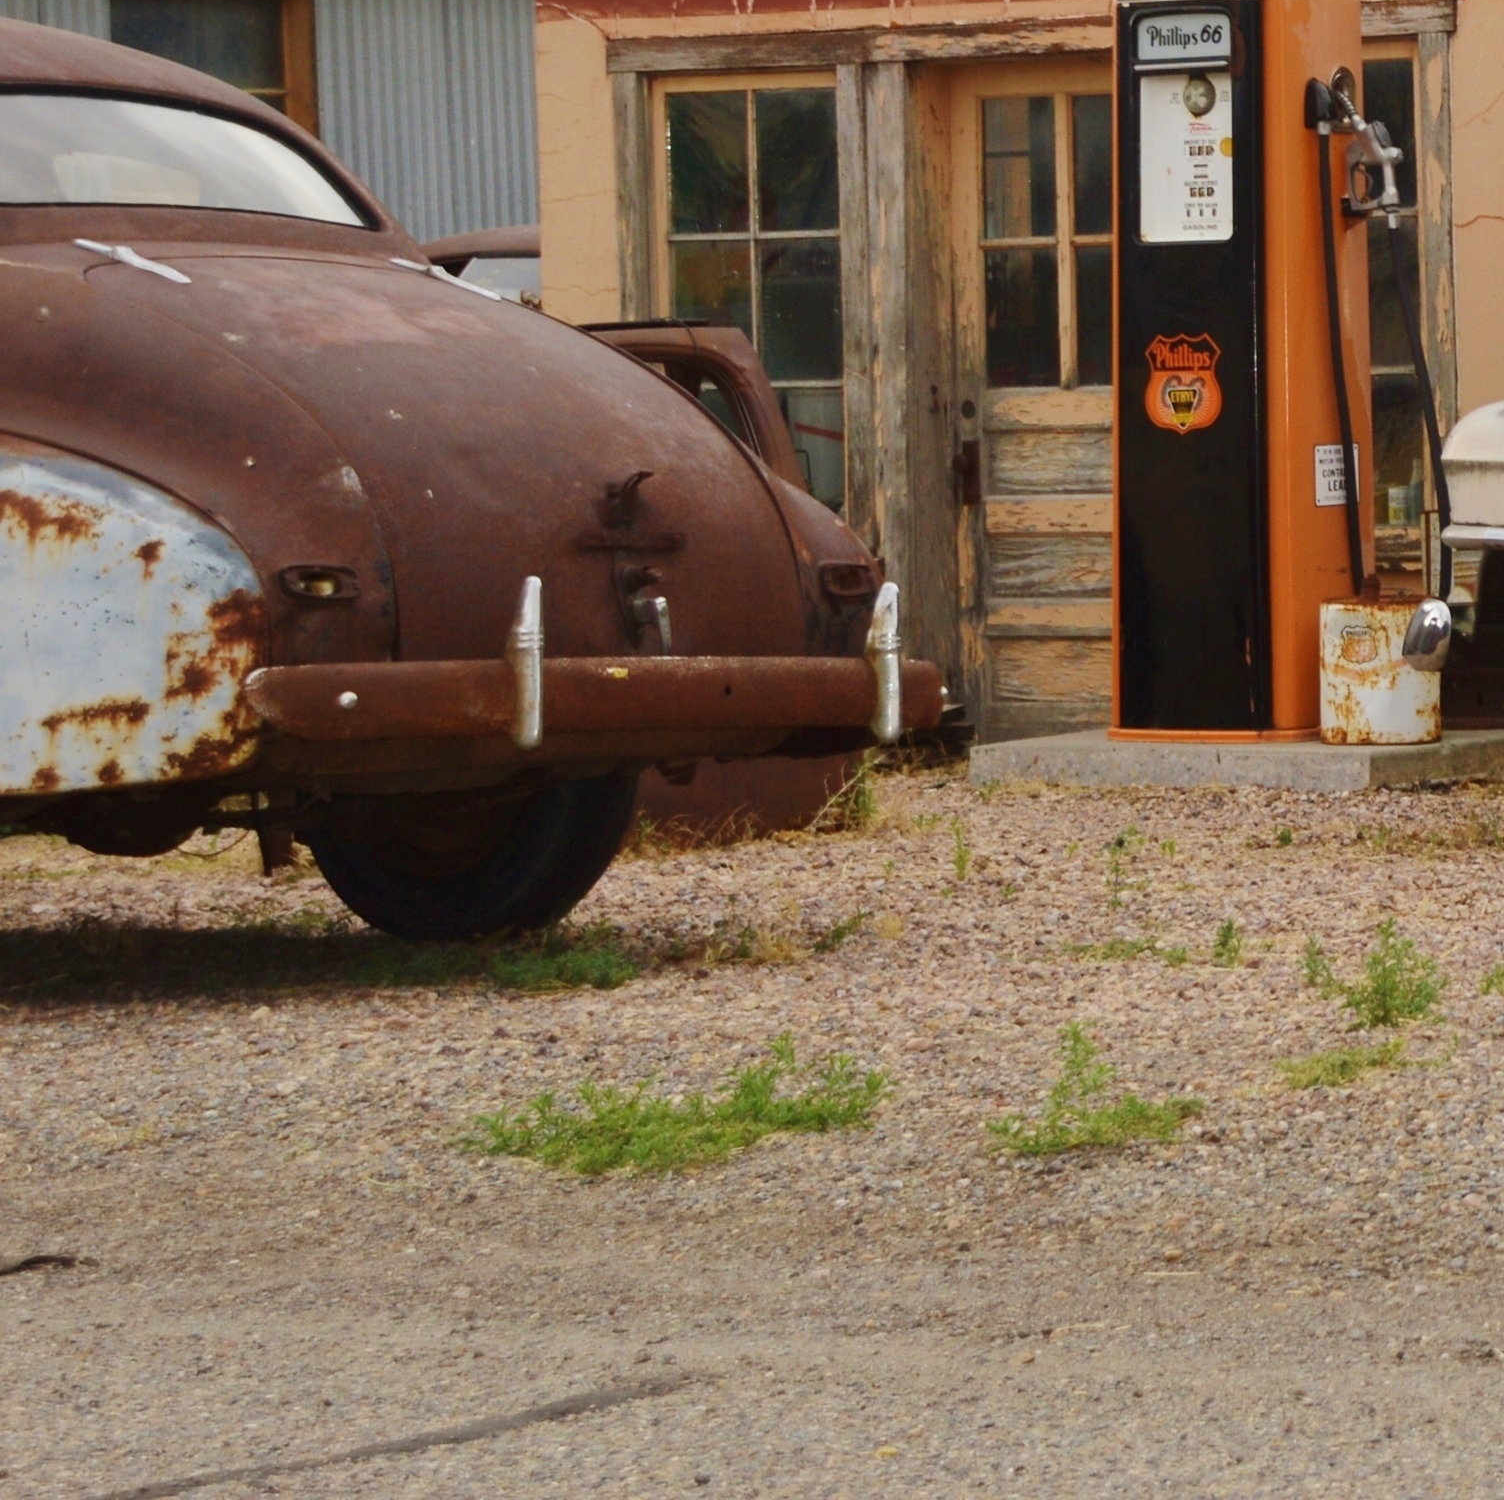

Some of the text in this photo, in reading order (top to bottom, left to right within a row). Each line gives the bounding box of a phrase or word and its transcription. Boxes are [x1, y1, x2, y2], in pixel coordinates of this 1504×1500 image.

[1146, 24, 1223, 50] Phillips 66
[1152, 343, 1211, 372] Phillips
[1170, 390, 1194, 403] ETHYL
[1322, 468, 1345, 478] CONTA
[1328, 480, 1345, 492] LEA
